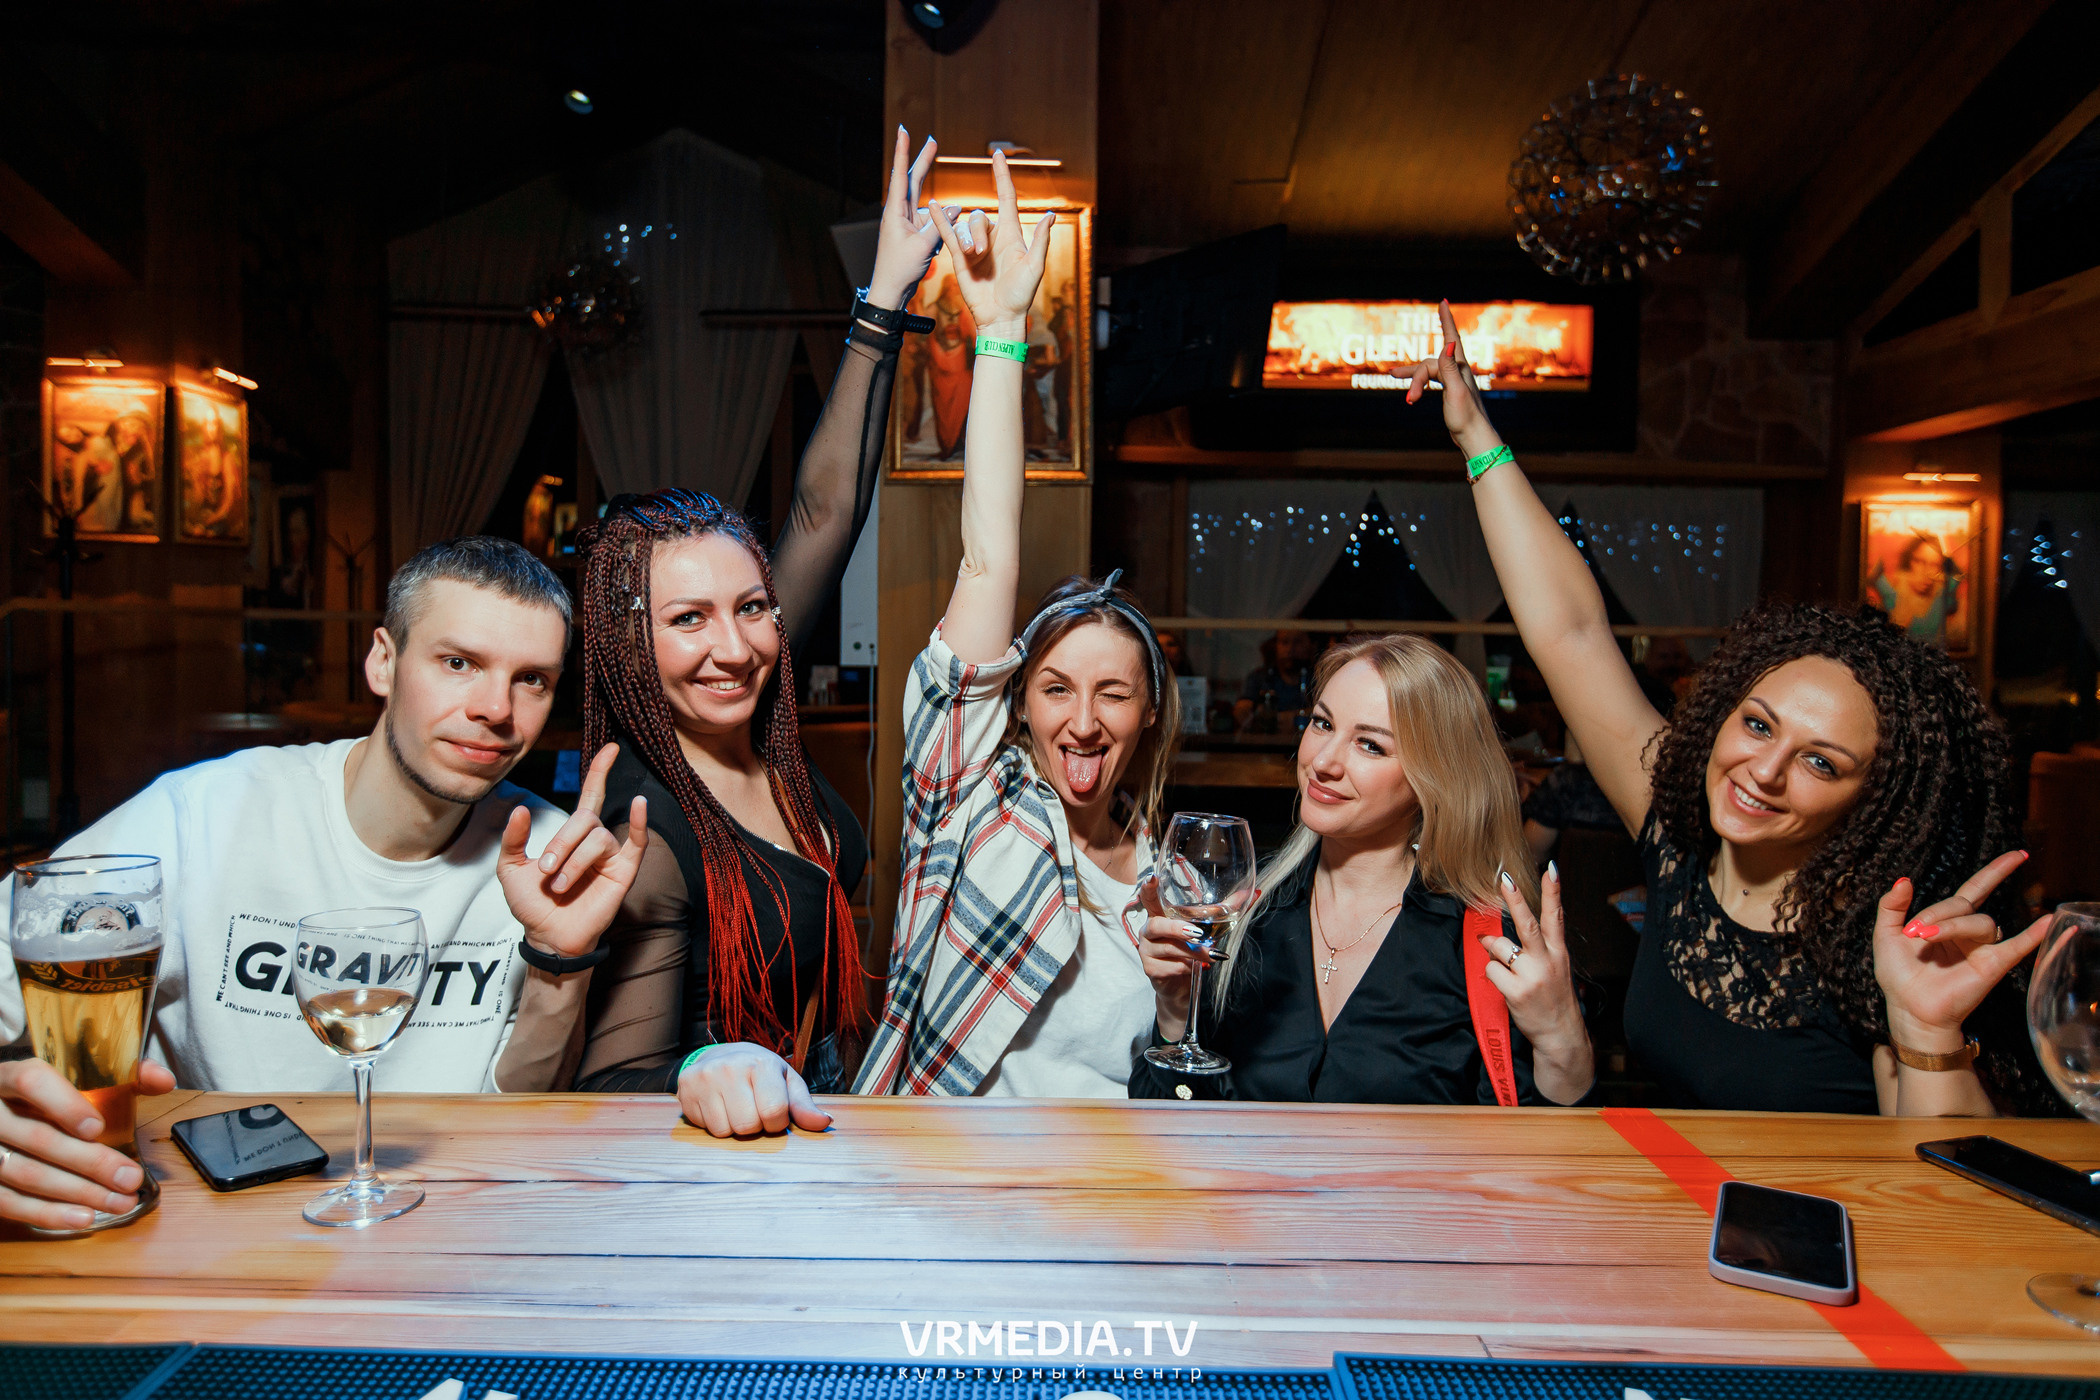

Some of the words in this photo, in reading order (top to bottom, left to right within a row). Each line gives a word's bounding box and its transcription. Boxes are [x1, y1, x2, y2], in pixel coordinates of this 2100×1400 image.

[1340, 334, 1499, 369] GLENLIET
[239, 912, 252, 920] WE
[215, 990, 225, 1002] WE
[224, 1000, 239, 1011] THAT
[240, 1005, 261, 1016] THING
[263, 1009, 282, 1018] ONE
[282, 1012, 292, 1020] IS
[1485, 1028, 1506, 1072] LOUIS
